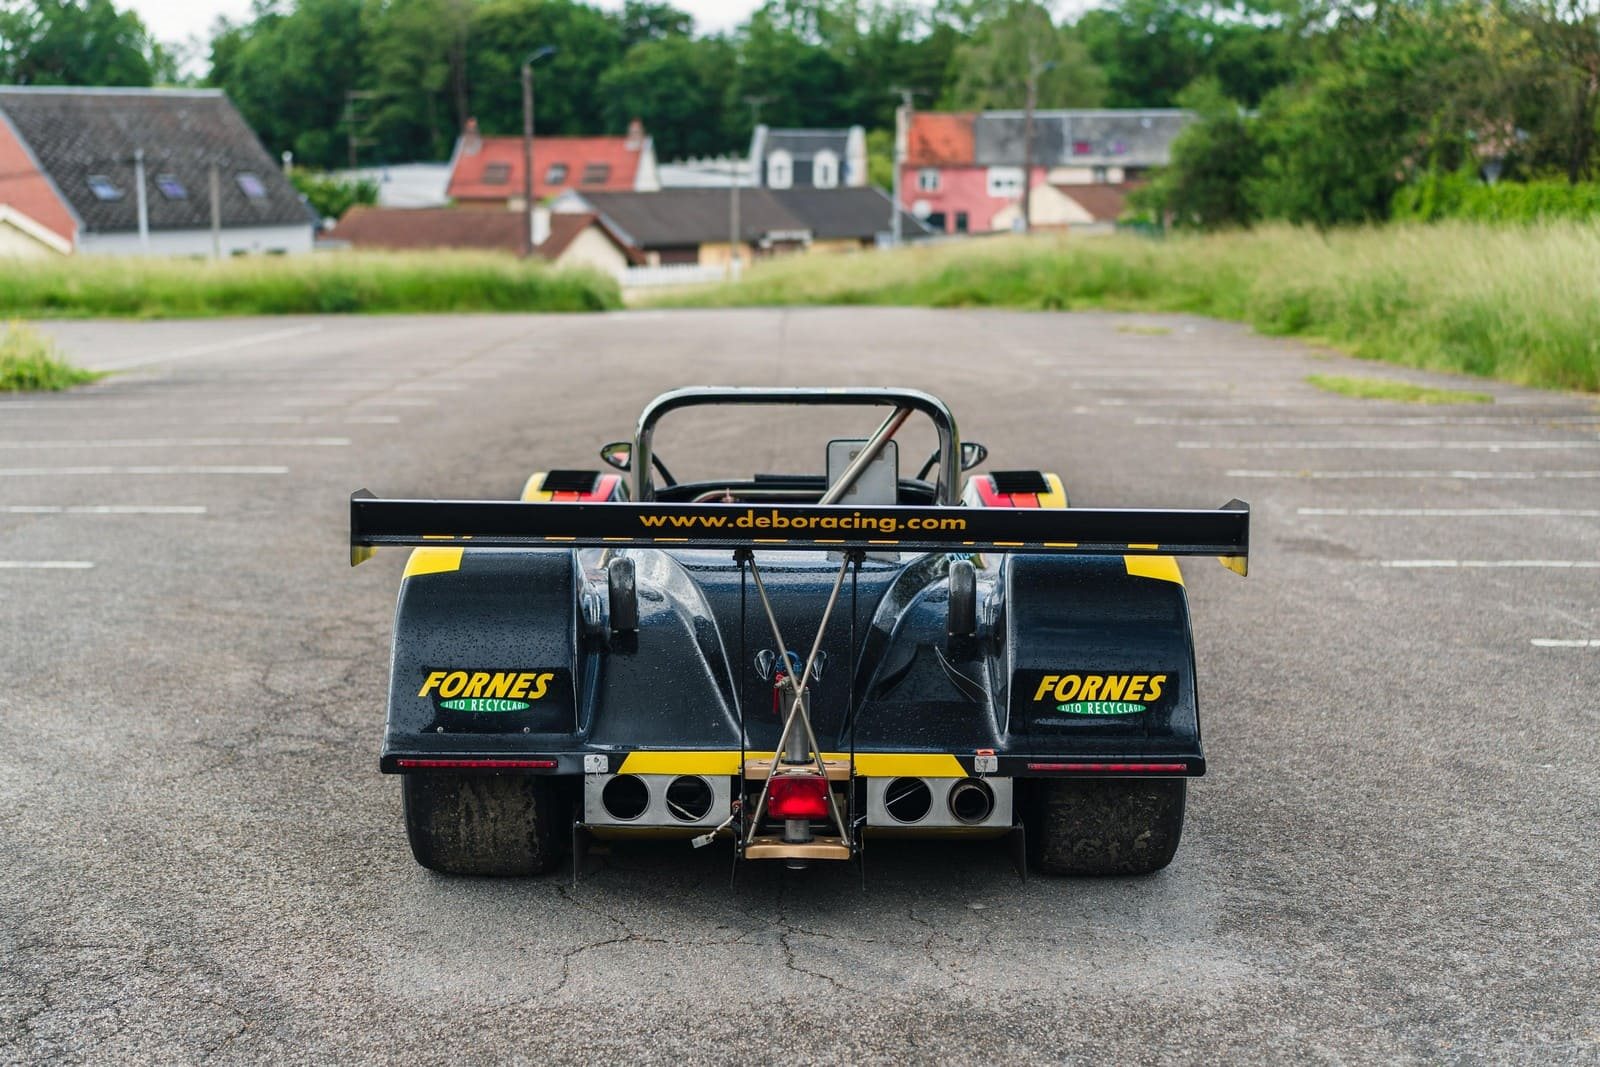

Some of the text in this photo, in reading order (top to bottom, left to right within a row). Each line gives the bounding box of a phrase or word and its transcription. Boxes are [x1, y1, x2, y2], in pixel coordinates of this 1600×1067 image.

[639, 510, 967, 533] www.deboracing.com
[417, 671, 555, 699] FORNES
[1033, 674, 1167, 702] FORNES
[445, 700, 466, 710] AUTO
[1061, 702, 1082, 713] AUTO
